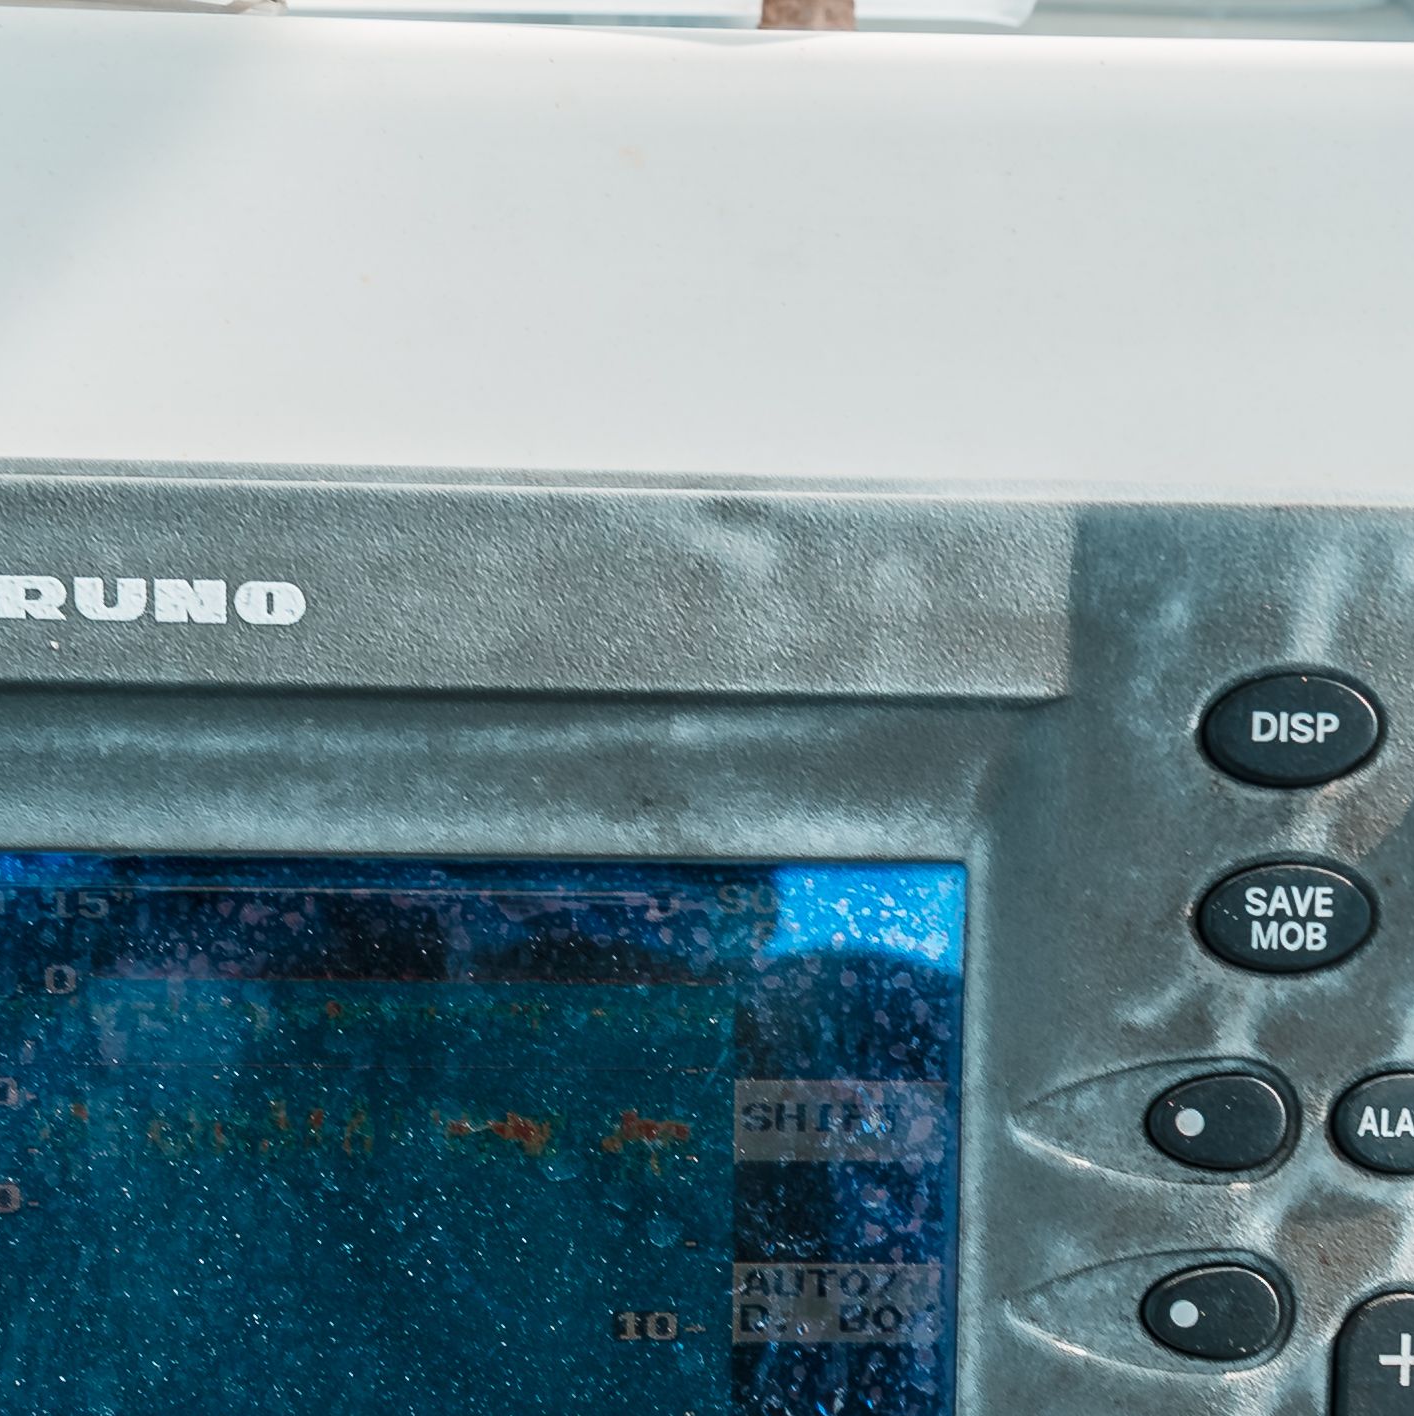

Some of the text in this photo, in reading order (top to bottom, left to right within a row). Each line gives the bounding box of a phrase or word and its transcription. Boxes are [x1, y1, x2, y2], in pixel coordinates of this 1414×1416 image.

[1251, 711, 1339, 743] DISP
[1244, 887, 1333, 917] SAVE
[1251, 921, 1326, 951] MOB
[618, 1311, 678, 1341] 10
